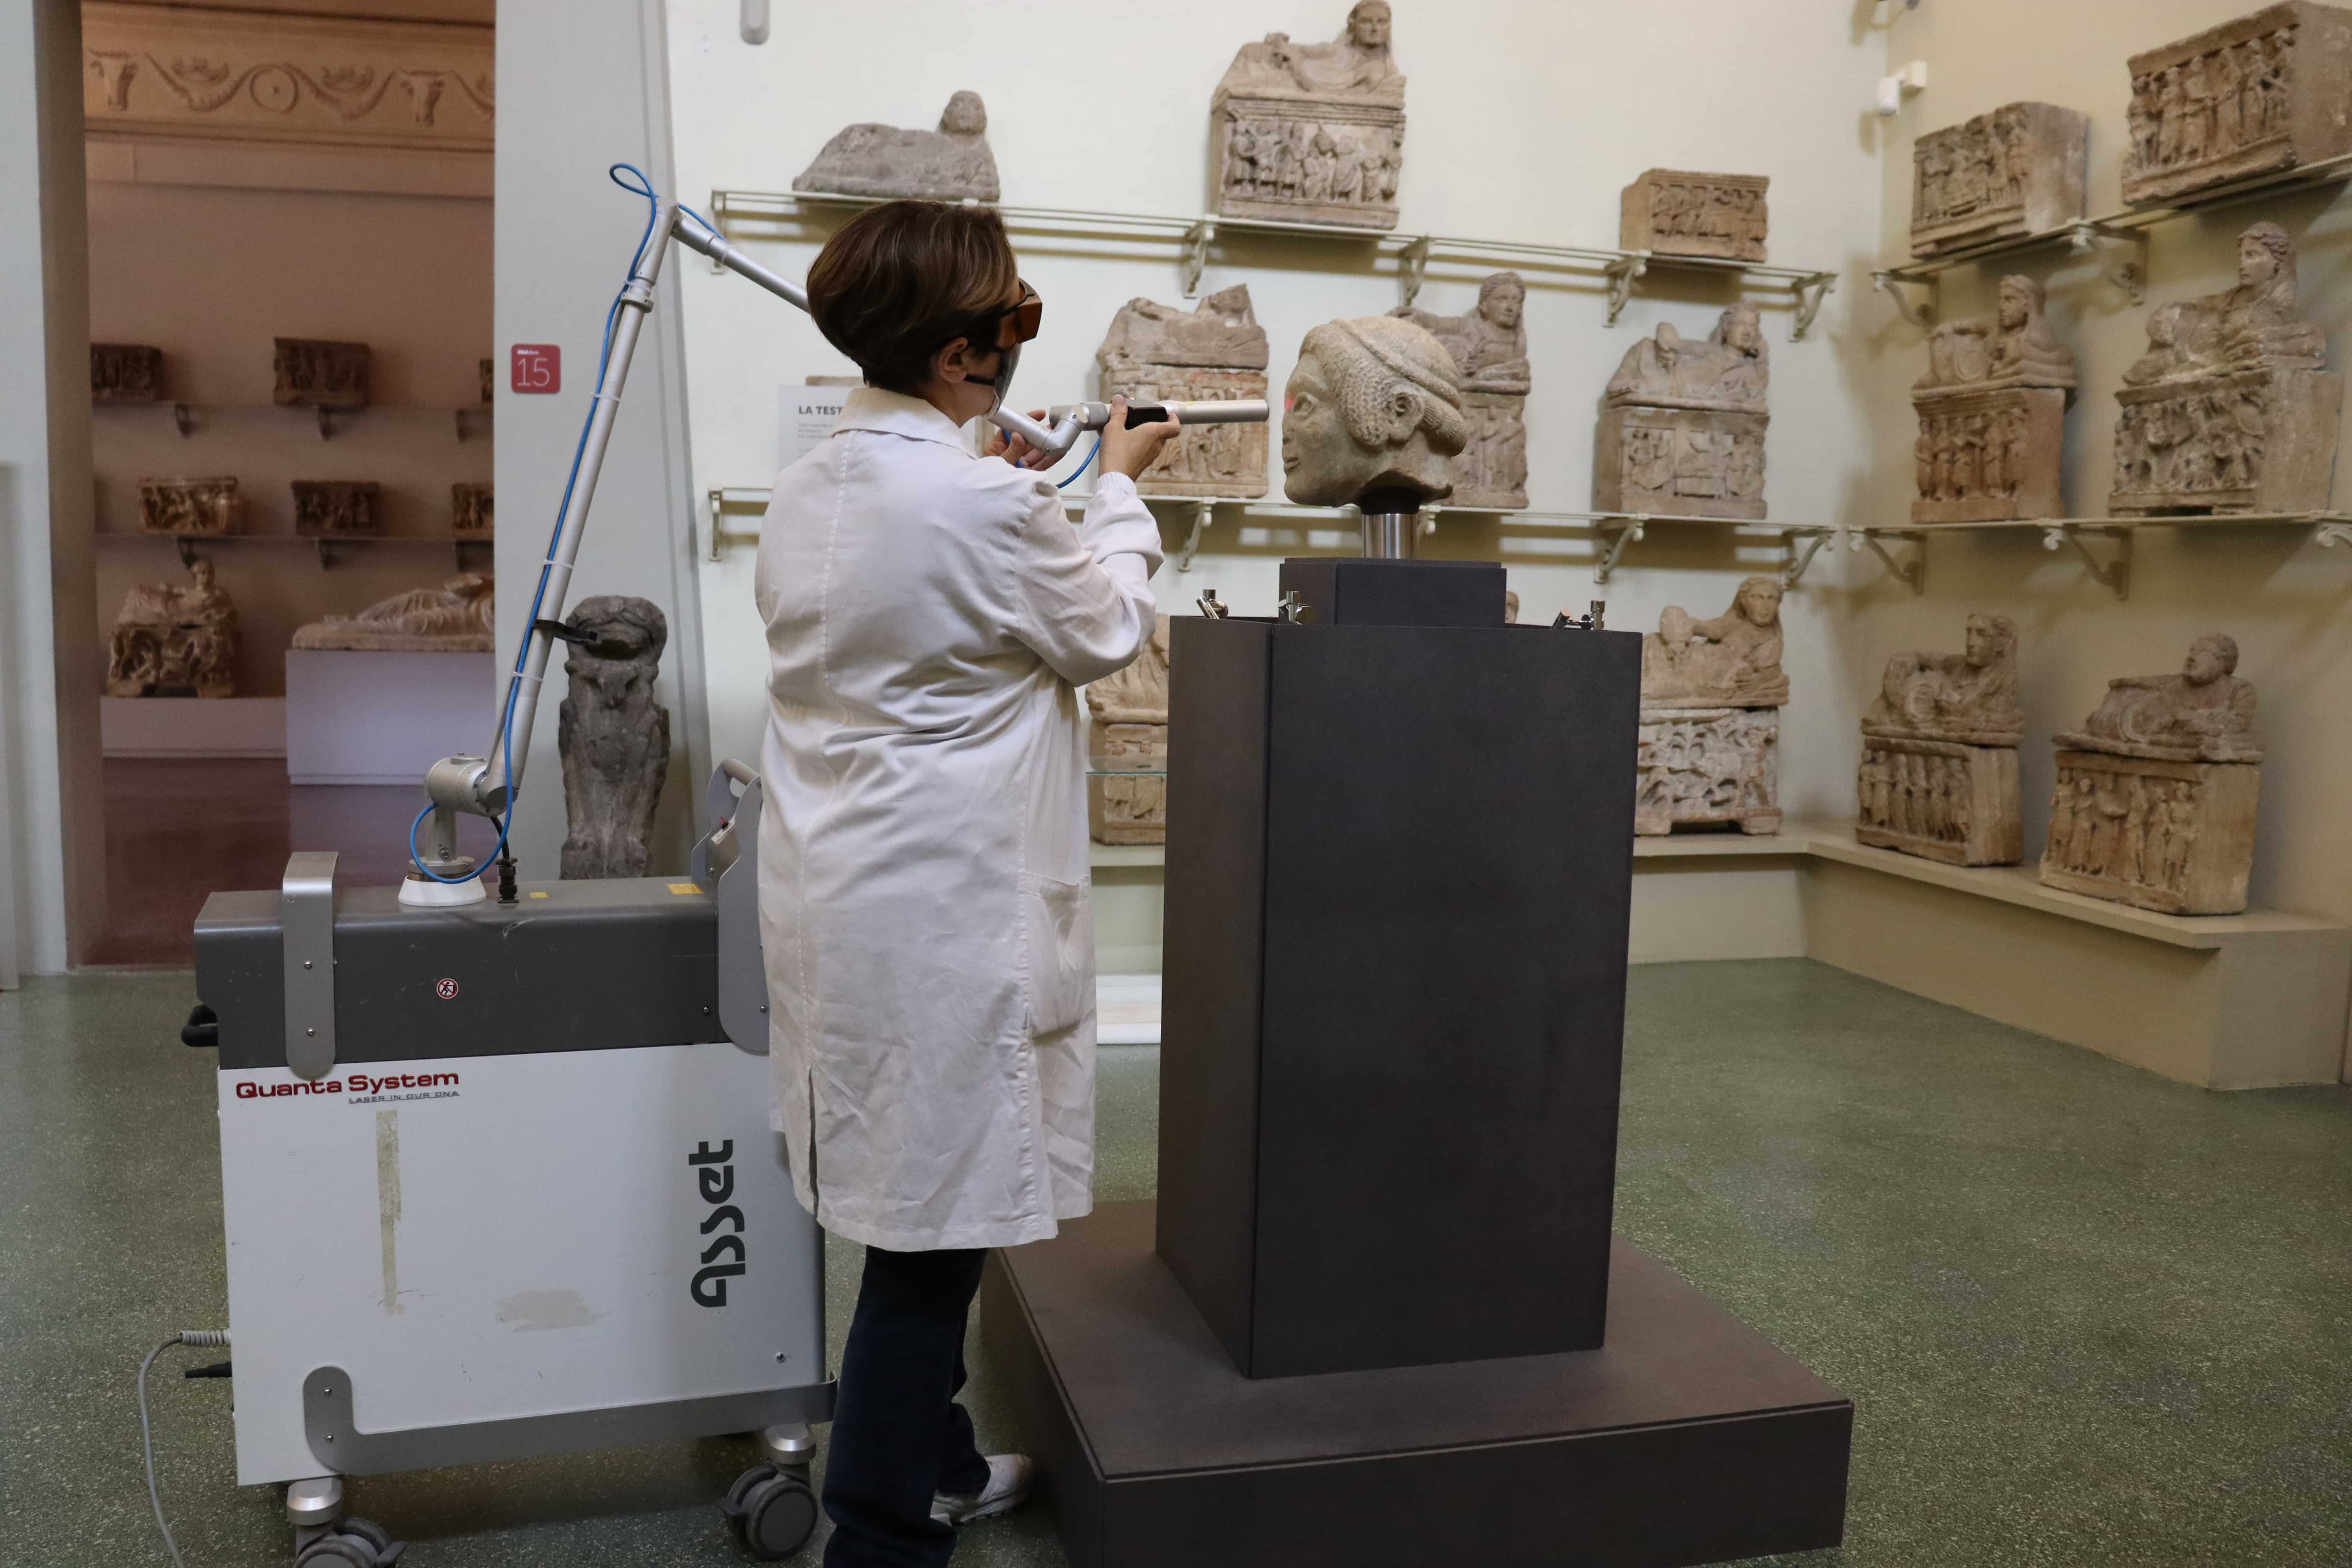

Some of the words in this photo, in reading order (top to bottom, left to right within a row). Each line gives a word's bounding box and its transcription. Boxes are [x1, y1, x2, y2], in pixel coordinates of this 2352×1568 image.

[517, 358, 550, 387] 15
[799, 406, 813, 414] LA
[236, 1080, 342, 1099] Quanta
[348, 1073, 459, 1094] System
[348, 1096, 385, 1104] LASER
